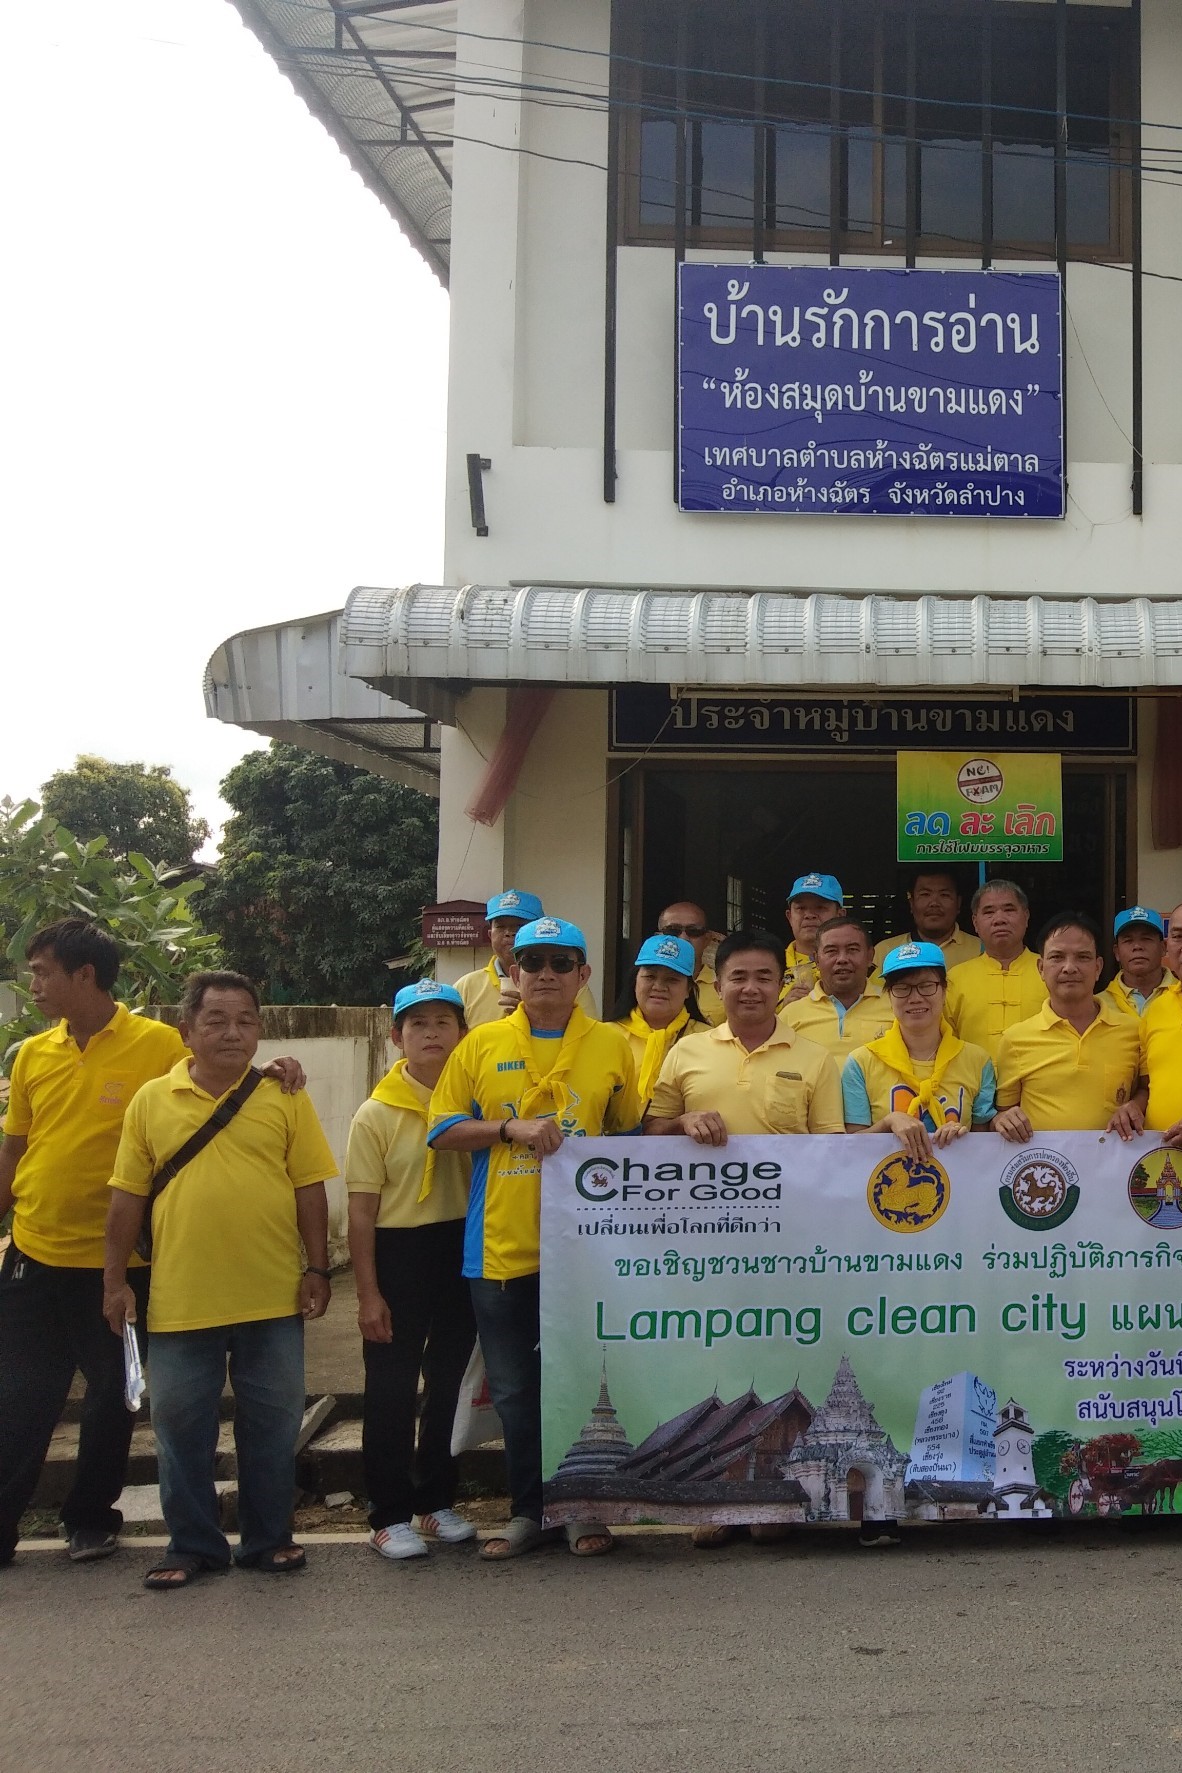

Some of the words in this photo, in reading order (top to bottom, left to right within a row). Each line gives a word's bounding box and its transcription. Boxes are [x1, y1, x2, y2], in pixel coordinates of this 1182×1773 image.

[703, 278, 1040, 355] บ้านรักการอ่าน
[702, 367, 1040, 423] “ห้องสมุดบ้านขามแดง”
[704, 440, 1039, 473] เทศบาลตำบลห้างฉัตรแม่ตาล
[722, 478, 870, 504] อำเภอห้างฉัตร
[888, 481, 1025, 507] จังหวัดลำปาง
[904, 811, 950, 836] ลด
[960, 811, 996, 836] ละ
[1004, 804, 1056, 836] เลิก
[916, 839, 1050, 858] การใช้โฟมบรรจุอาหาร
[497, 1060, 526, 1073] BIKER
[575, 1157, 782, 1202] Change
[622, 1184, 681, 1201] For
[690, 1184, 782, 1201] Good
[578, 1212, 781, 1236] เปลี่ยนเพื่อโลกที่ดีกว่า
[614, 1244, 962, 1283] ขอเชิญชวนชาวบ้านขามแดง
[597, 1300, 821, 1346] Lampang
[847, 1296, 977, 1336] clean
[1002, 1292, 1087, 1340] city
